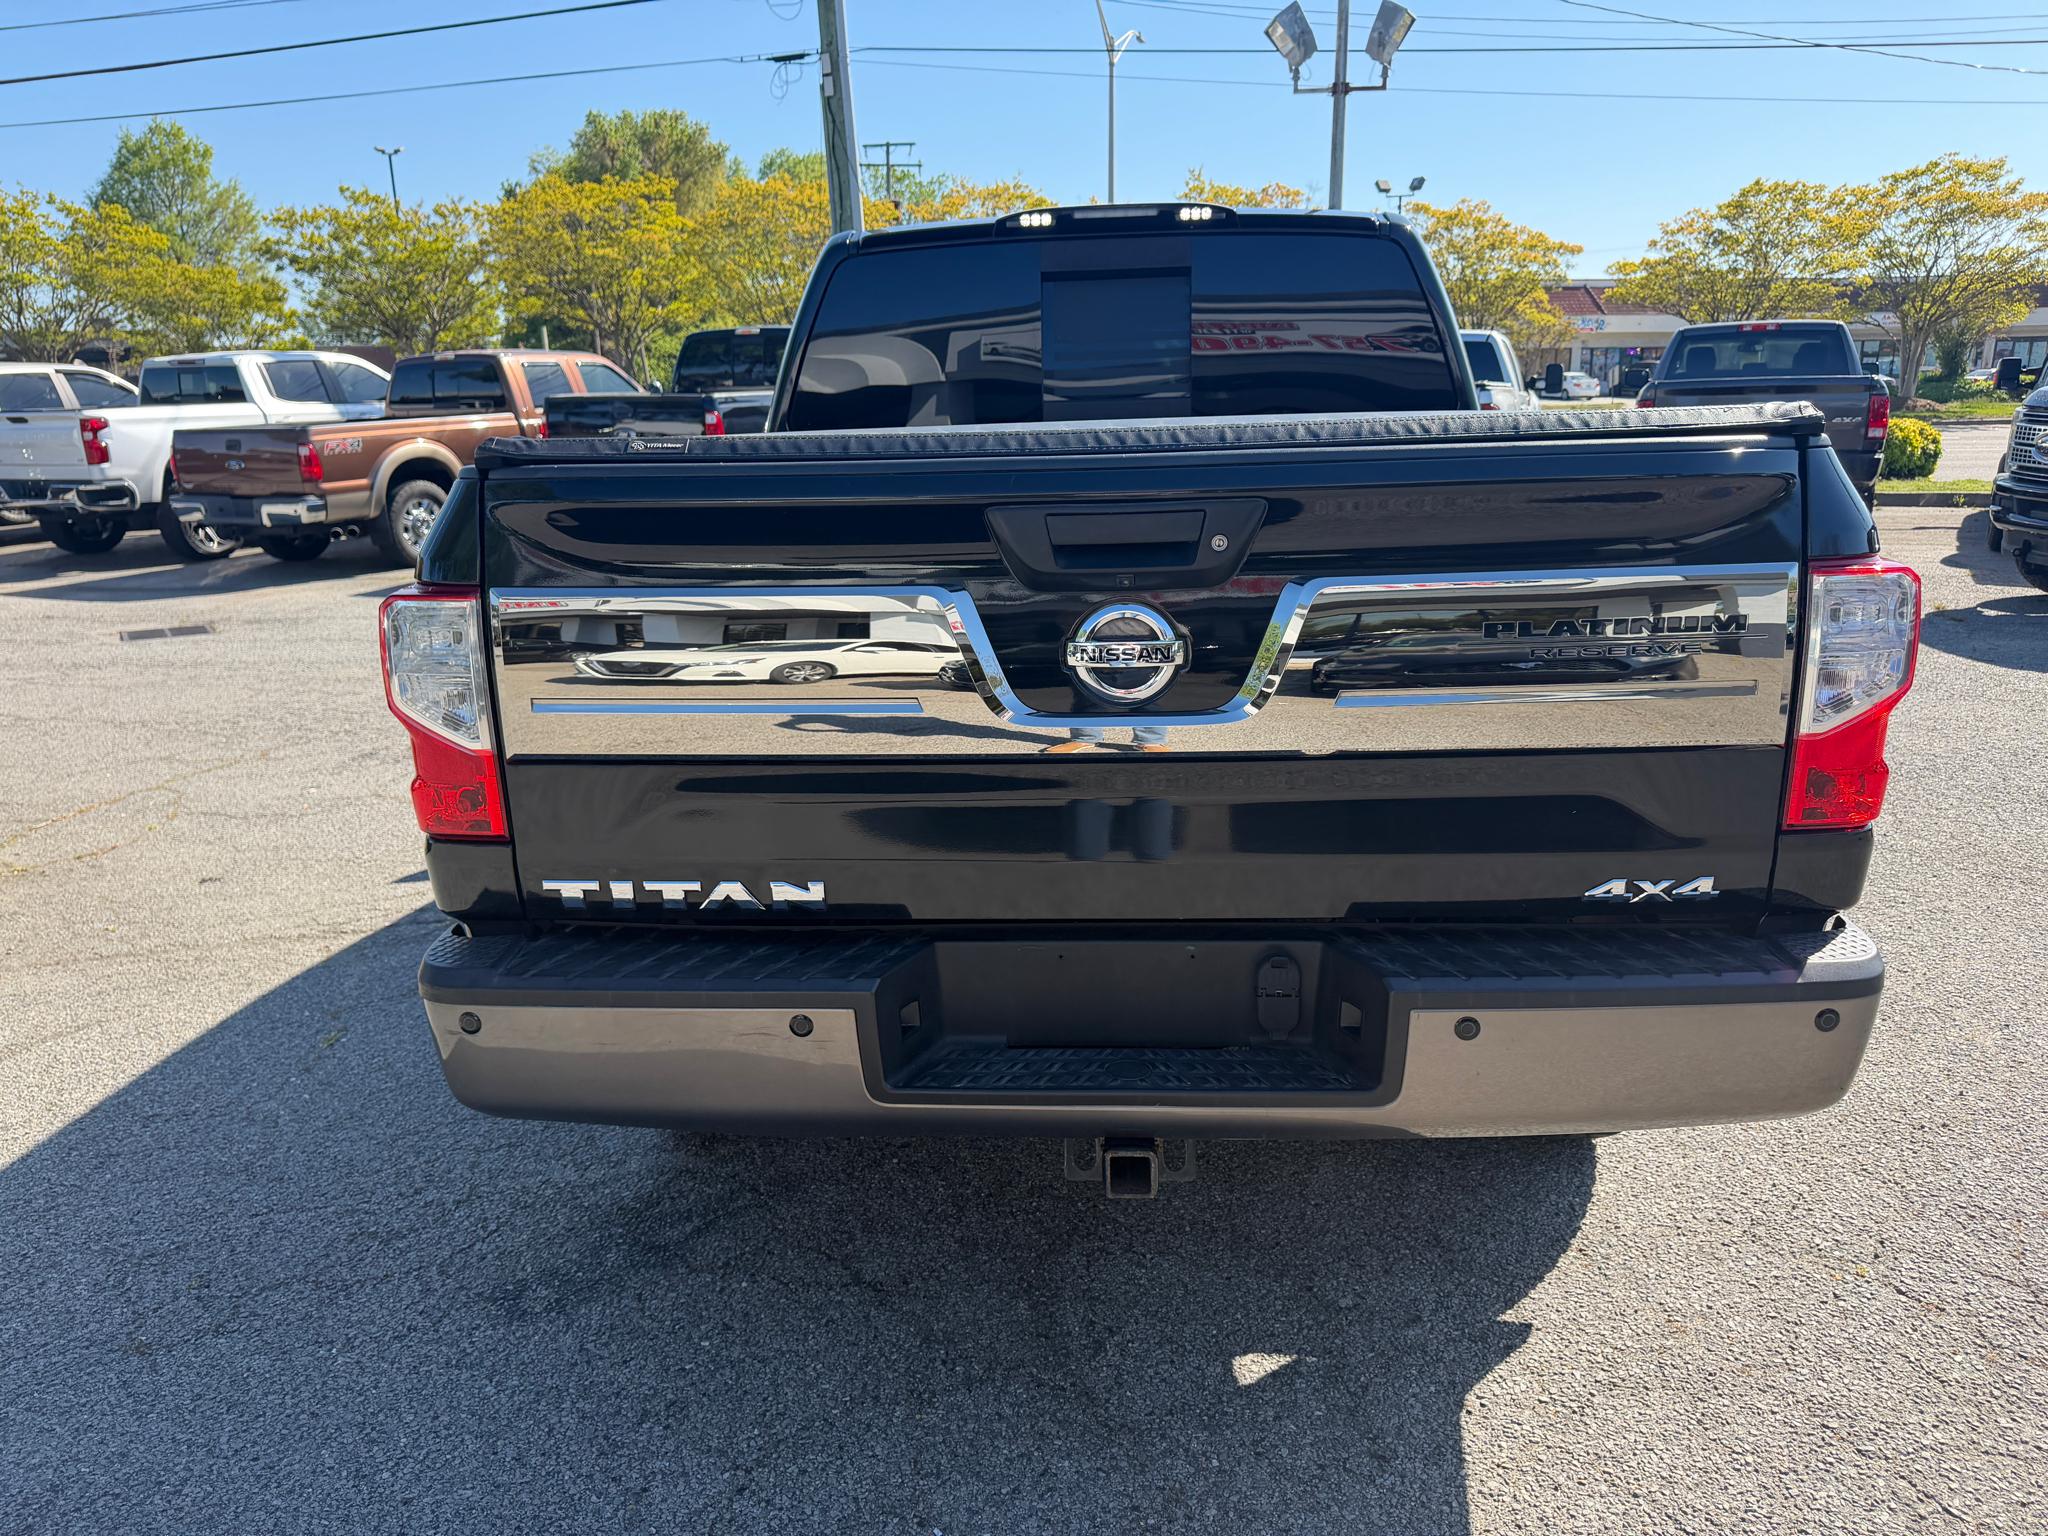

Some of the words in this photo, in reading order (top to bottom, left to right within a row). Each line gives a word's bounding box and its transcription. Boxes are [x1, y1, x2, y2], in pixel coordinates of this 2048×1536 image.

[1482, 614, 1750, 639] PLATINUM
[1078, 646, 1174, 663] NISSAN
[1529, 642, 1703, 658] RESERVE
[542, 879, 828, 911] TITAN
[1584, 876, 1721, 904] 4X4
